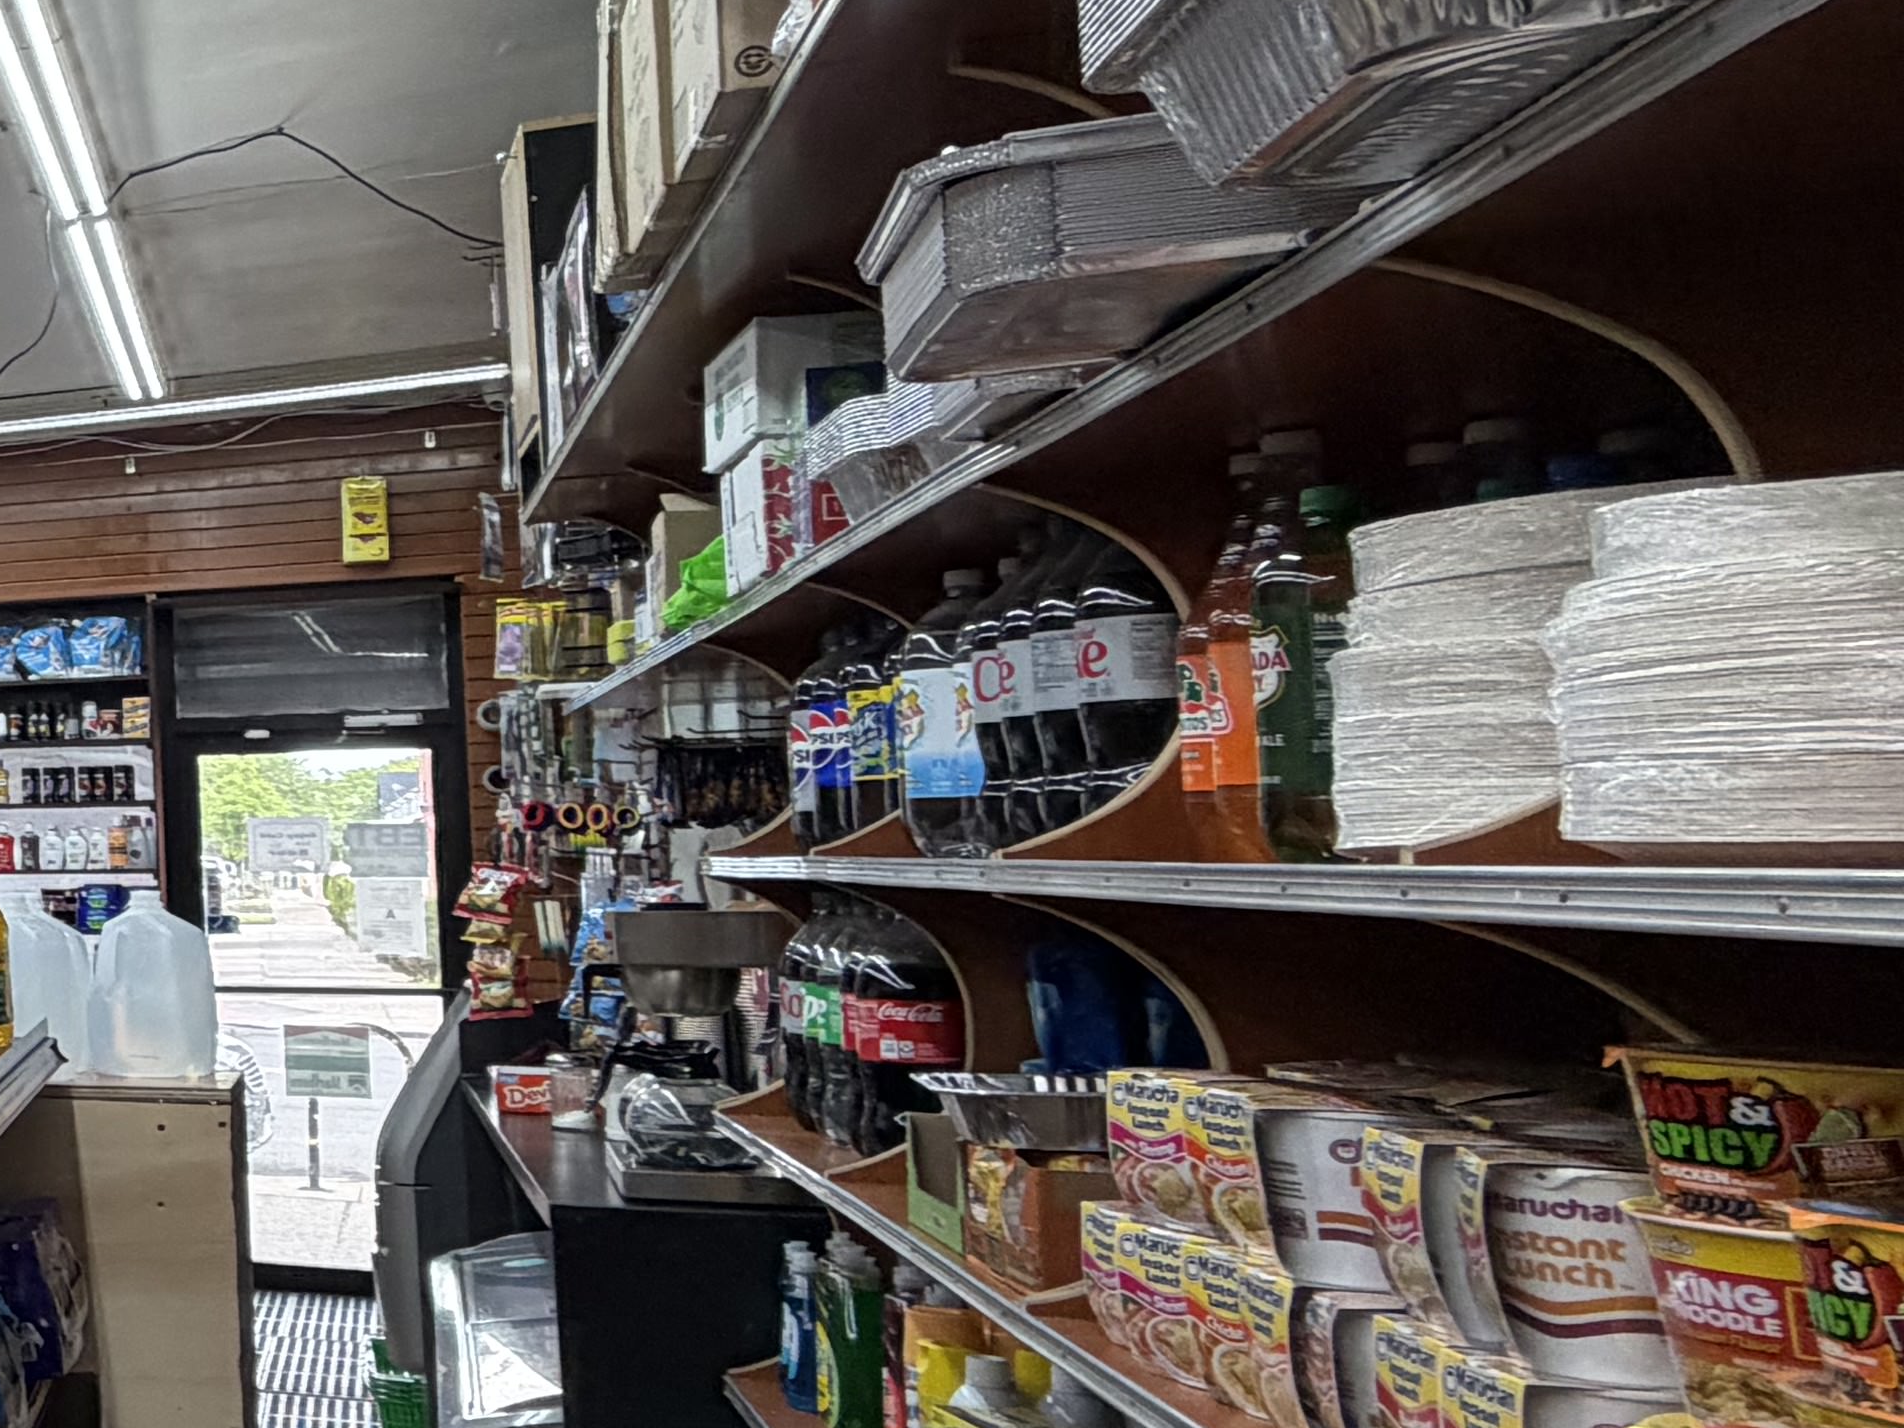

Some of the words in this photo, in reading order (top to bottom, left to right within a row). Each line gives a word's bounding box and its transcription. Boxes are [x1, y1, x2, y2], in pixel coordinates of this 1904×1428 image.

[1124, 1082, 1180, 1104] Marucha
[1196, 1095, 1243, 1119] Maruch
[1640, 1073, 1731, 1123] HOT
[1729, 1094, 1776, 1127] &
[1648, 1118, 1779, 1168] SPICY
[1494, 1193, 1626, 1224] arucha
[1135, 1233, 1181, 1260] Maruc
[1198, 1254, 1240, 1281] Maruc
[1668, 1270, 1780, 1316] KING
[1676, 1300, 1784, 1339] NOODLE
